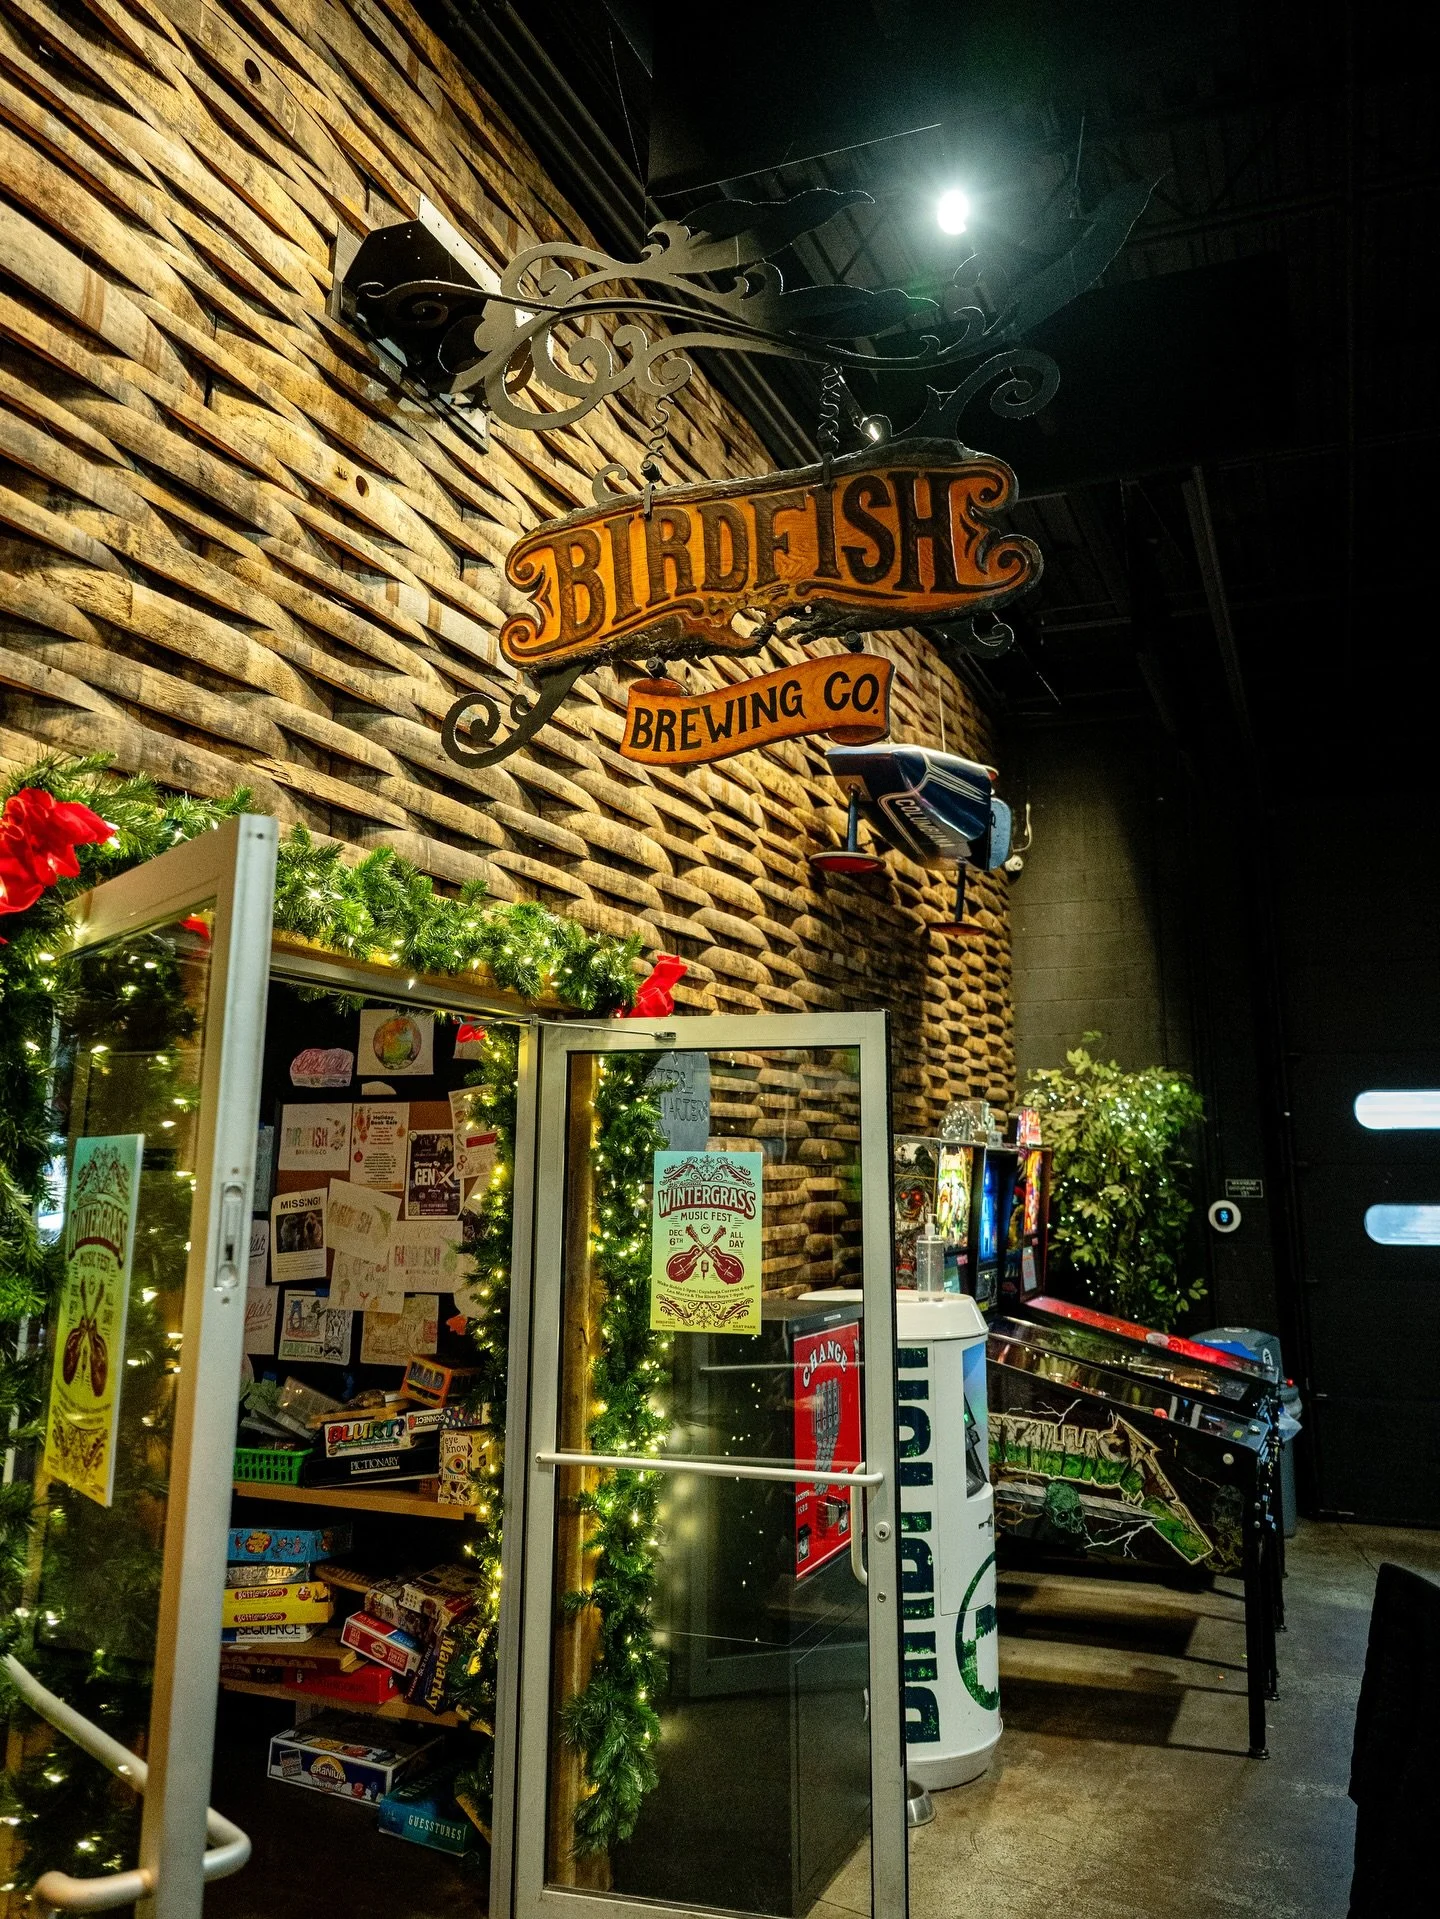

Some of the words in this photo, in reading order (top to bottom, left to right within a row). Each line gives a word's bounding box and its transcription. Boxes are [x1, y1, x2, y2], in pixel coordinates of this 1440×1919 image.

[549, 470, 961, 646] BIRDFISH
[629, 680, 804, 753] BREWING
[415, 1168, 436, 1187] GEN
[658, 1185, 757, 1220] WINTERGRASS
[681, 1211, 708, 1221] MUSIC
[711, 1212, 732, 1222] FEST
[730, 1231, 743, 1239] ALL
[669, 1237, 684, 1246] 6TH
[728, 1240, 745, 1248] DAY
[803, 1340, 848, 1388] CHANGE
[415, 1414, 445, 1425] CONNECT
[444, 1436, 459, 1446] eye
[446, 1444, 467, 1454] know
[350, 1456, 399, 1470] PICTIONARY
[239, 1624, 301, 1635] SEQUENCE
[425, 1634, 456, 1707] Malarky
[408, 1814, 463, 1841] GUESSTURES
